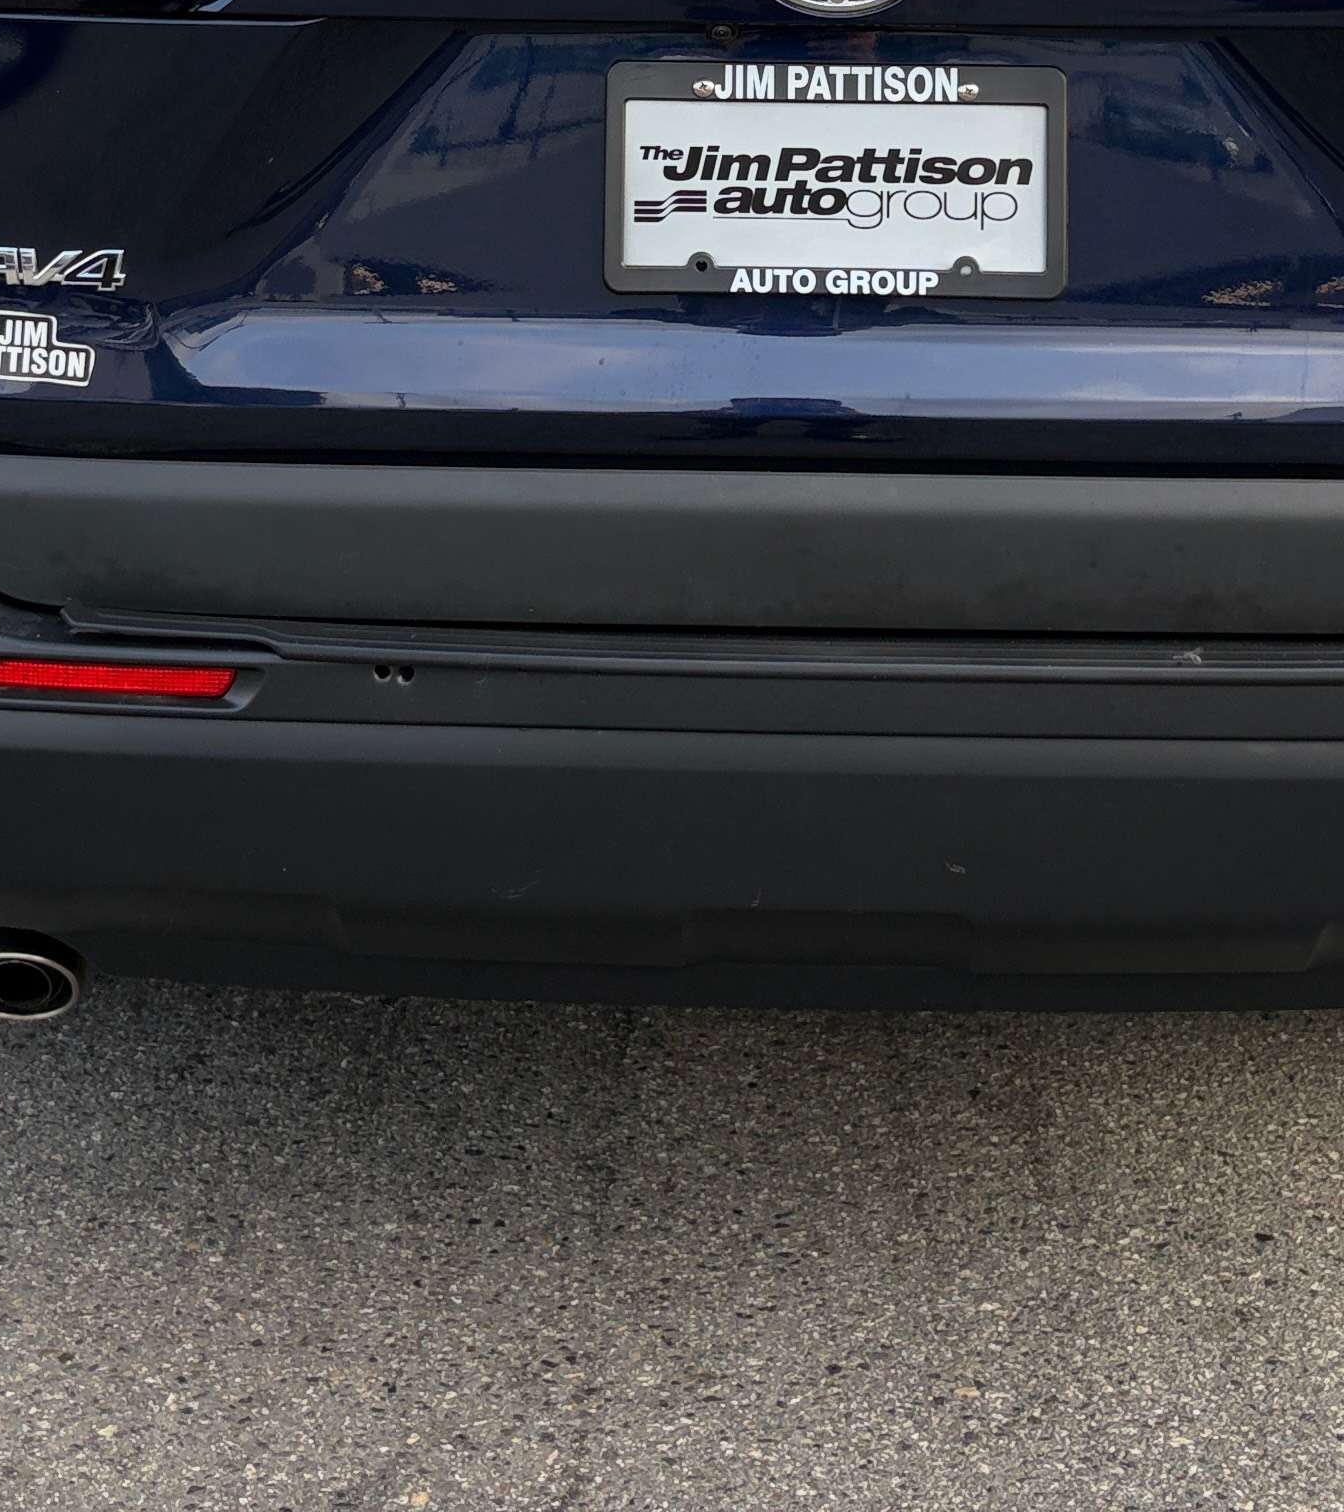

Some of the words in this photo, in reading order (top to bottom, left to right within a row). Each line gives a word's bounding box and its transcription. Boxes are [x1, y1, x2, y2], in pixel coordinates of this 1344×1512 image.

[714, 64, 775, 99] JIM
[787, 65, 959, 102] PATTISON
[639, 145, 684, 161] The
[730, 268, 816, 295] AUTO
[824, 270, 939, 296] GROUP
